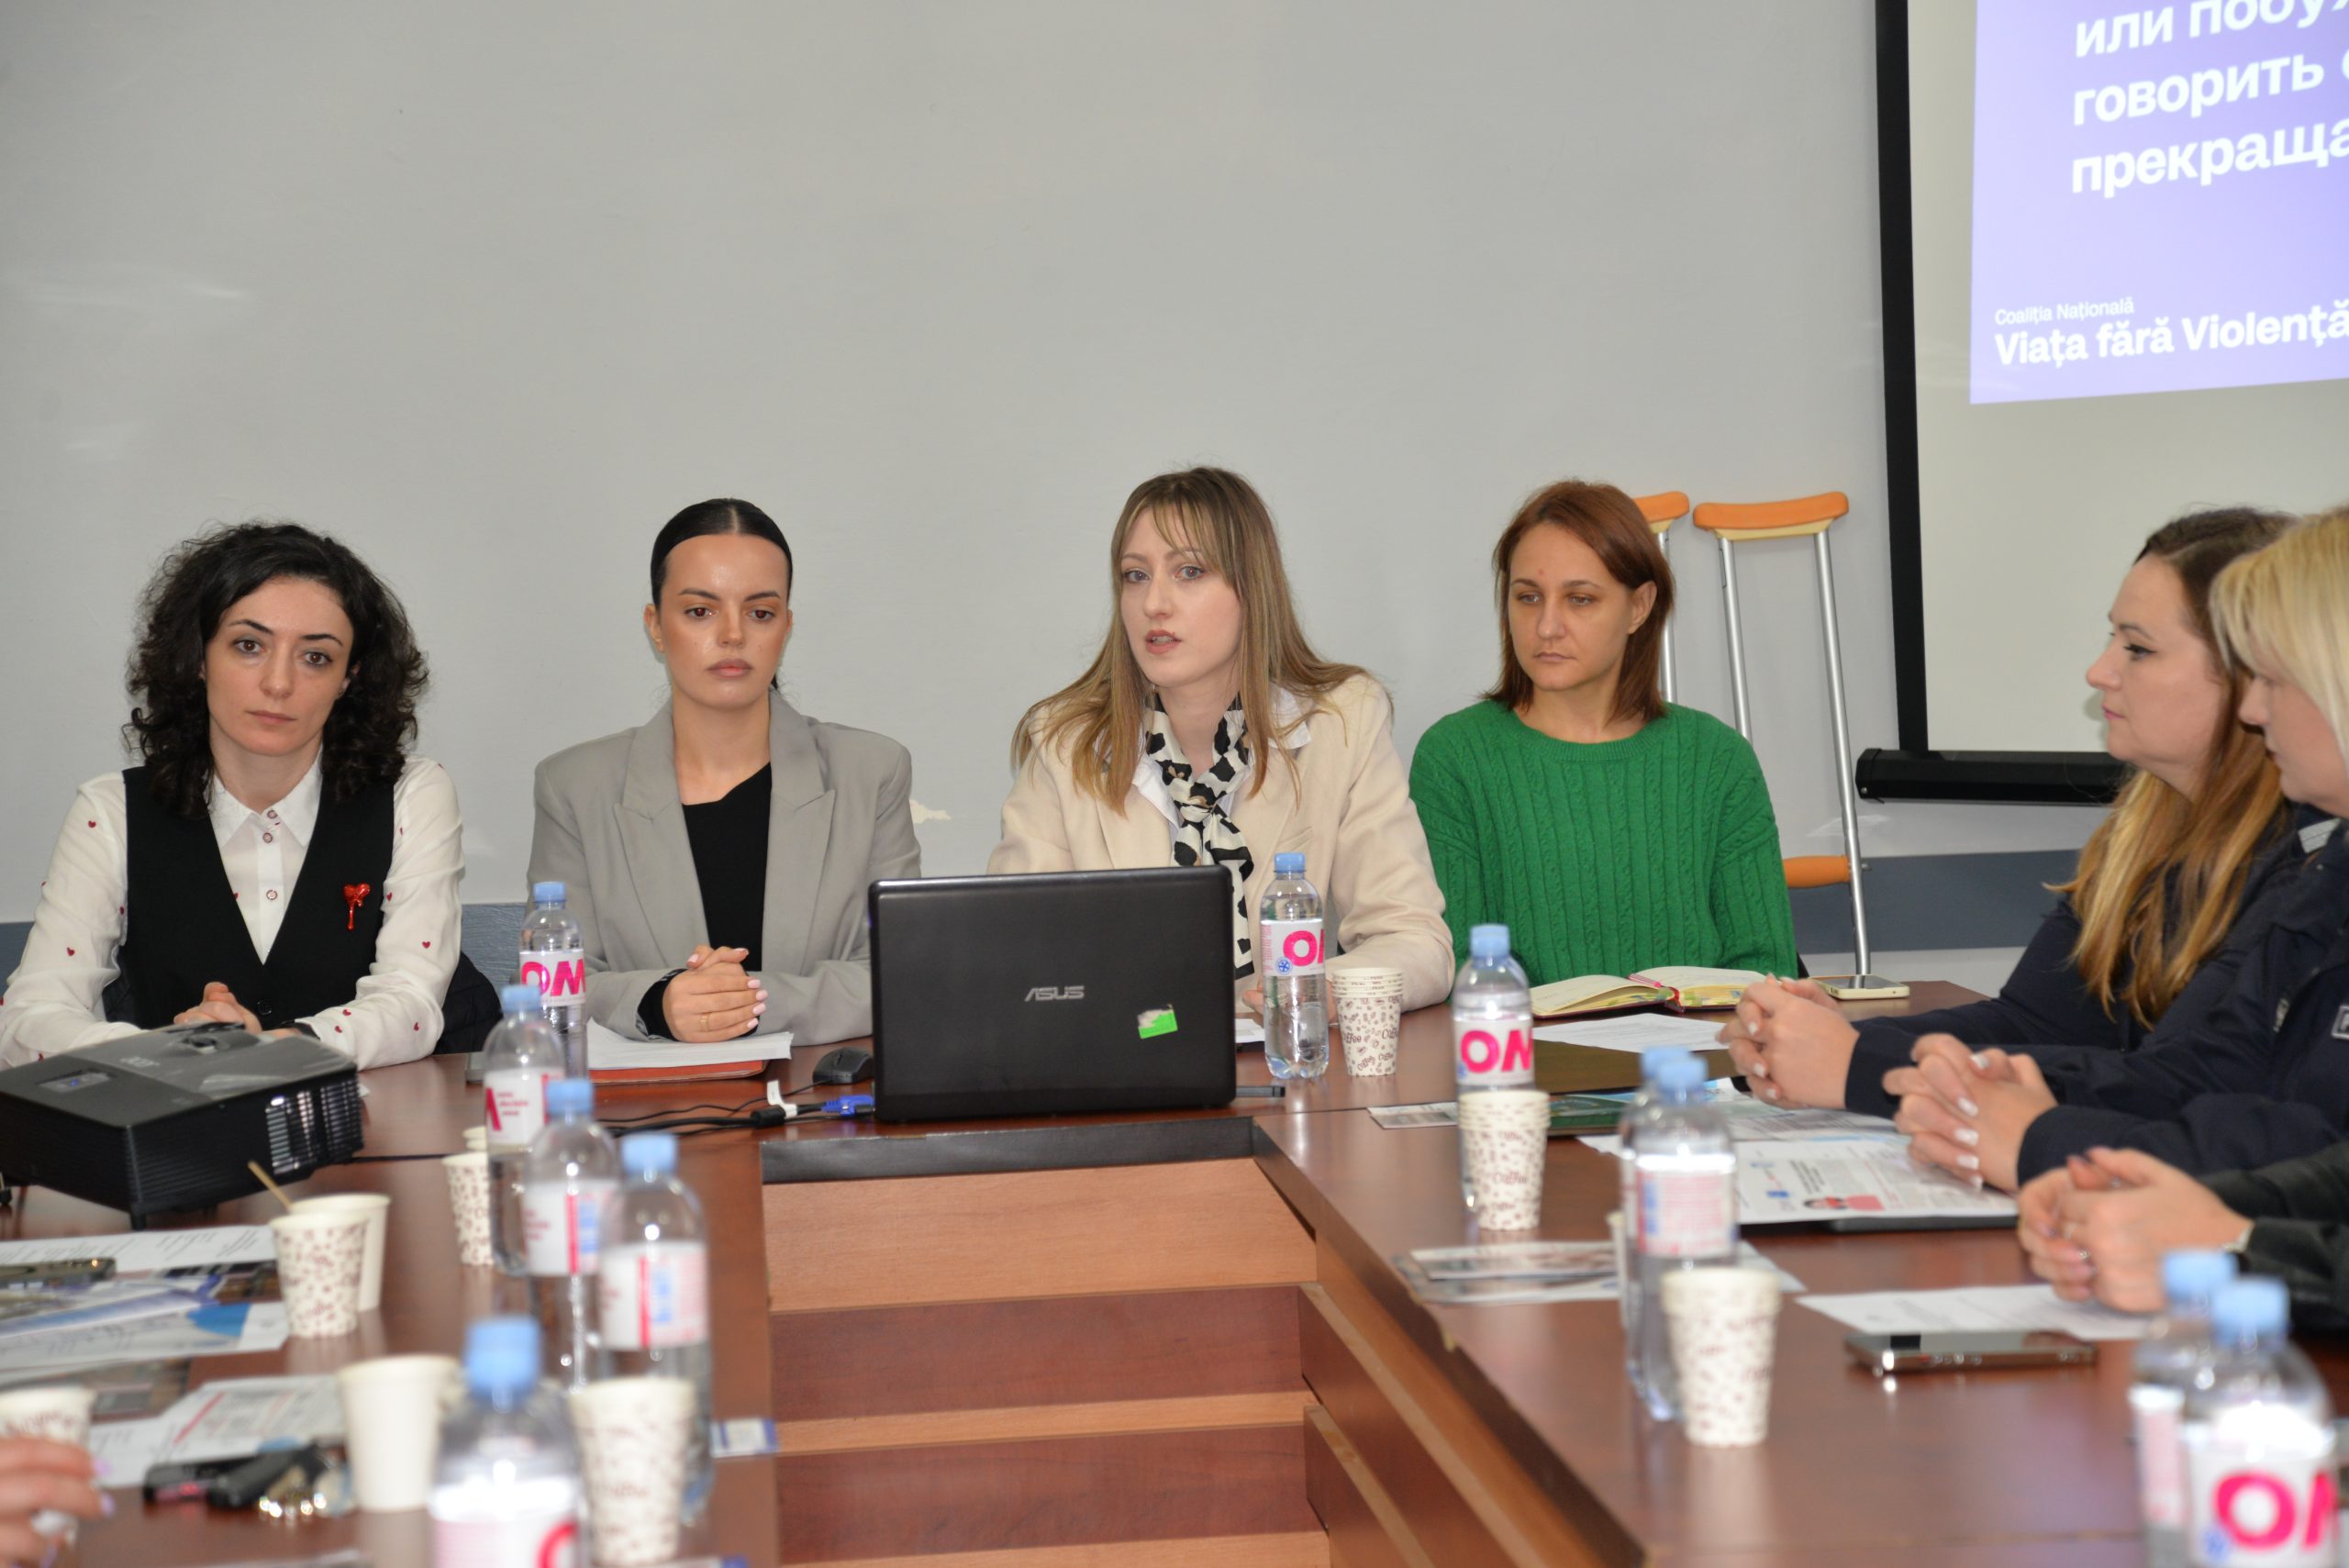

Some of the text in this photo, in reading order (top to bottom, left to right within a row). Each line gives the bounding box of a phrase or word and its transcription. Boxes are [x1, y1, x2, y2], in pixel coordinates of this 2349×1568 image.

[2076, 0, 2349, 57] или побу
[2074, 54, 2325, 126] говорить
[1994, 298, 2349, 369] Viața fără Violență
[1024, 985, 1085, 1002] ASUS
